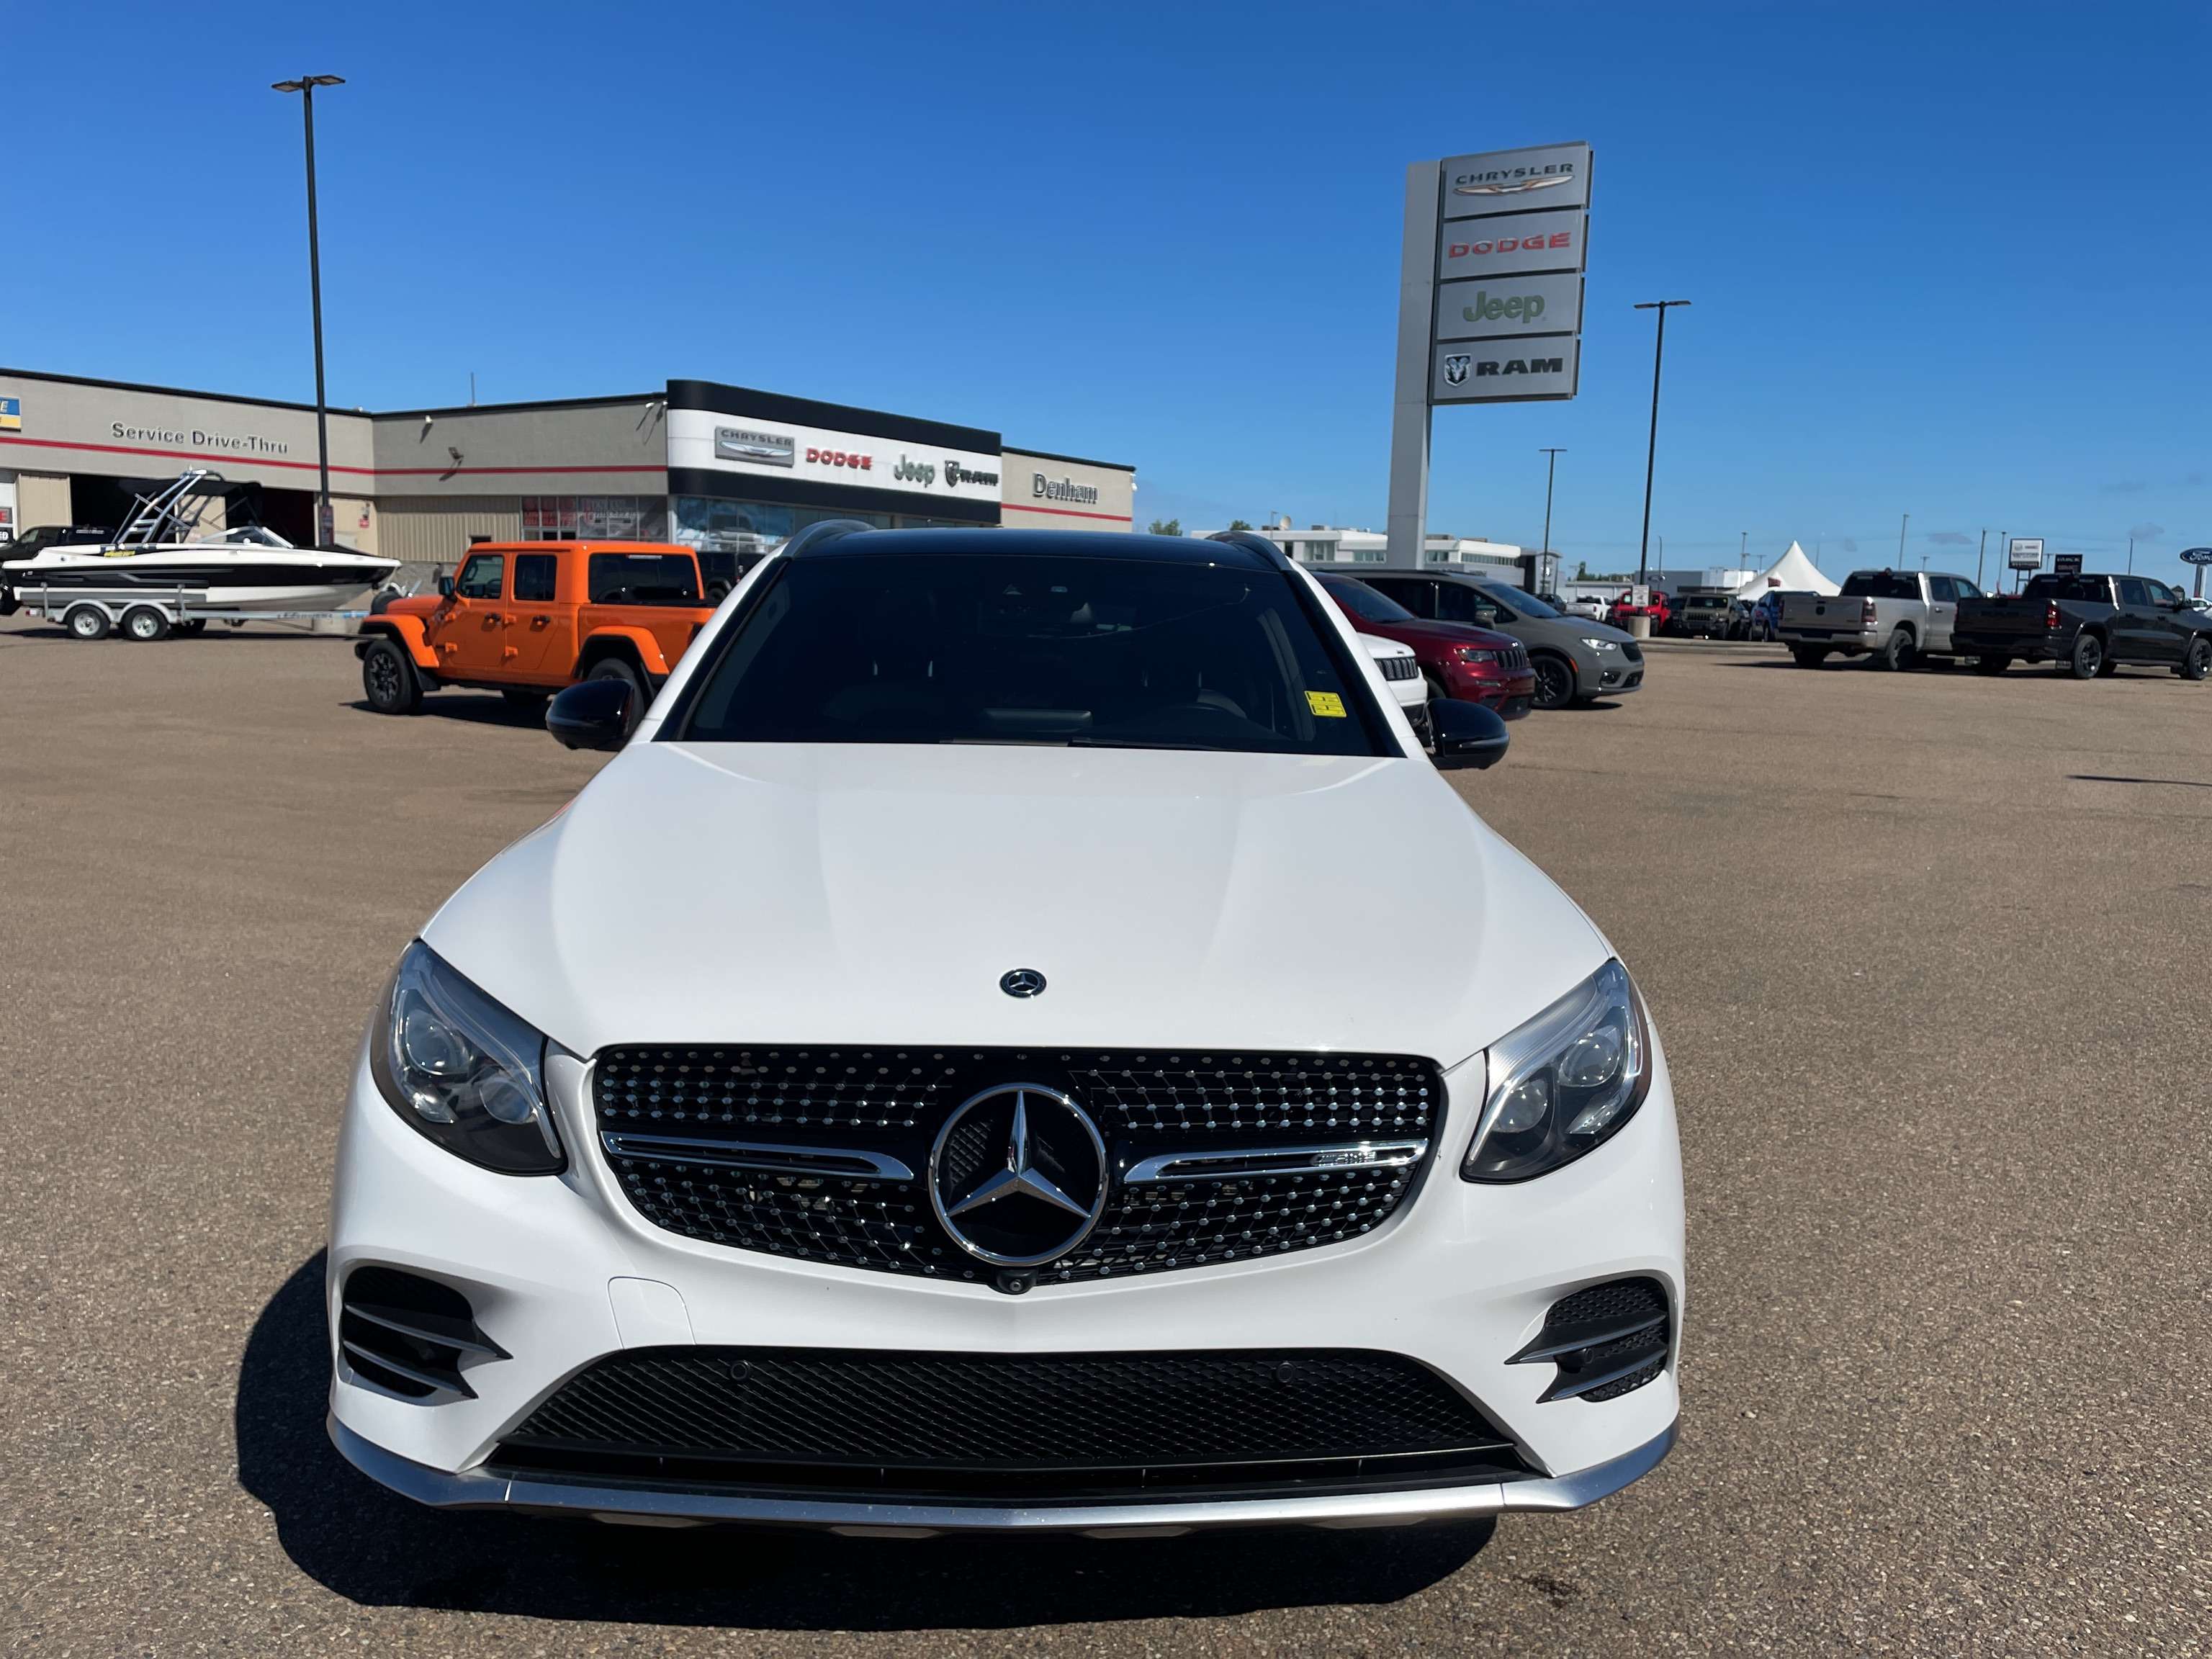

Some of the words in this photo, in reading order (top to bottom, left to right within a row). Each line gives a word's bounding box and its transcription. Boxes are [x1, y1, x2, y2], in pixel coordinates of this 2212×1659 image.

[1455, 163, 1574, 184] CHRYSLER
[1448, 232, 1572, 258] DODGE
[1462, 291, 1545, 323] Jeep
[1476, 358, 1563, 377] RAM
[112, 421, 185, 444] Service
[192, 430, 289, 454] Drive-Thru
[721, 429, 792, 446] CHRYSLER
[806, 447, 873, 470] DODGE
[894, 453, 935, 488] Jeep
[960, 468, 999, 487] RAM
[1033, 472, 1098, 504] Denham
